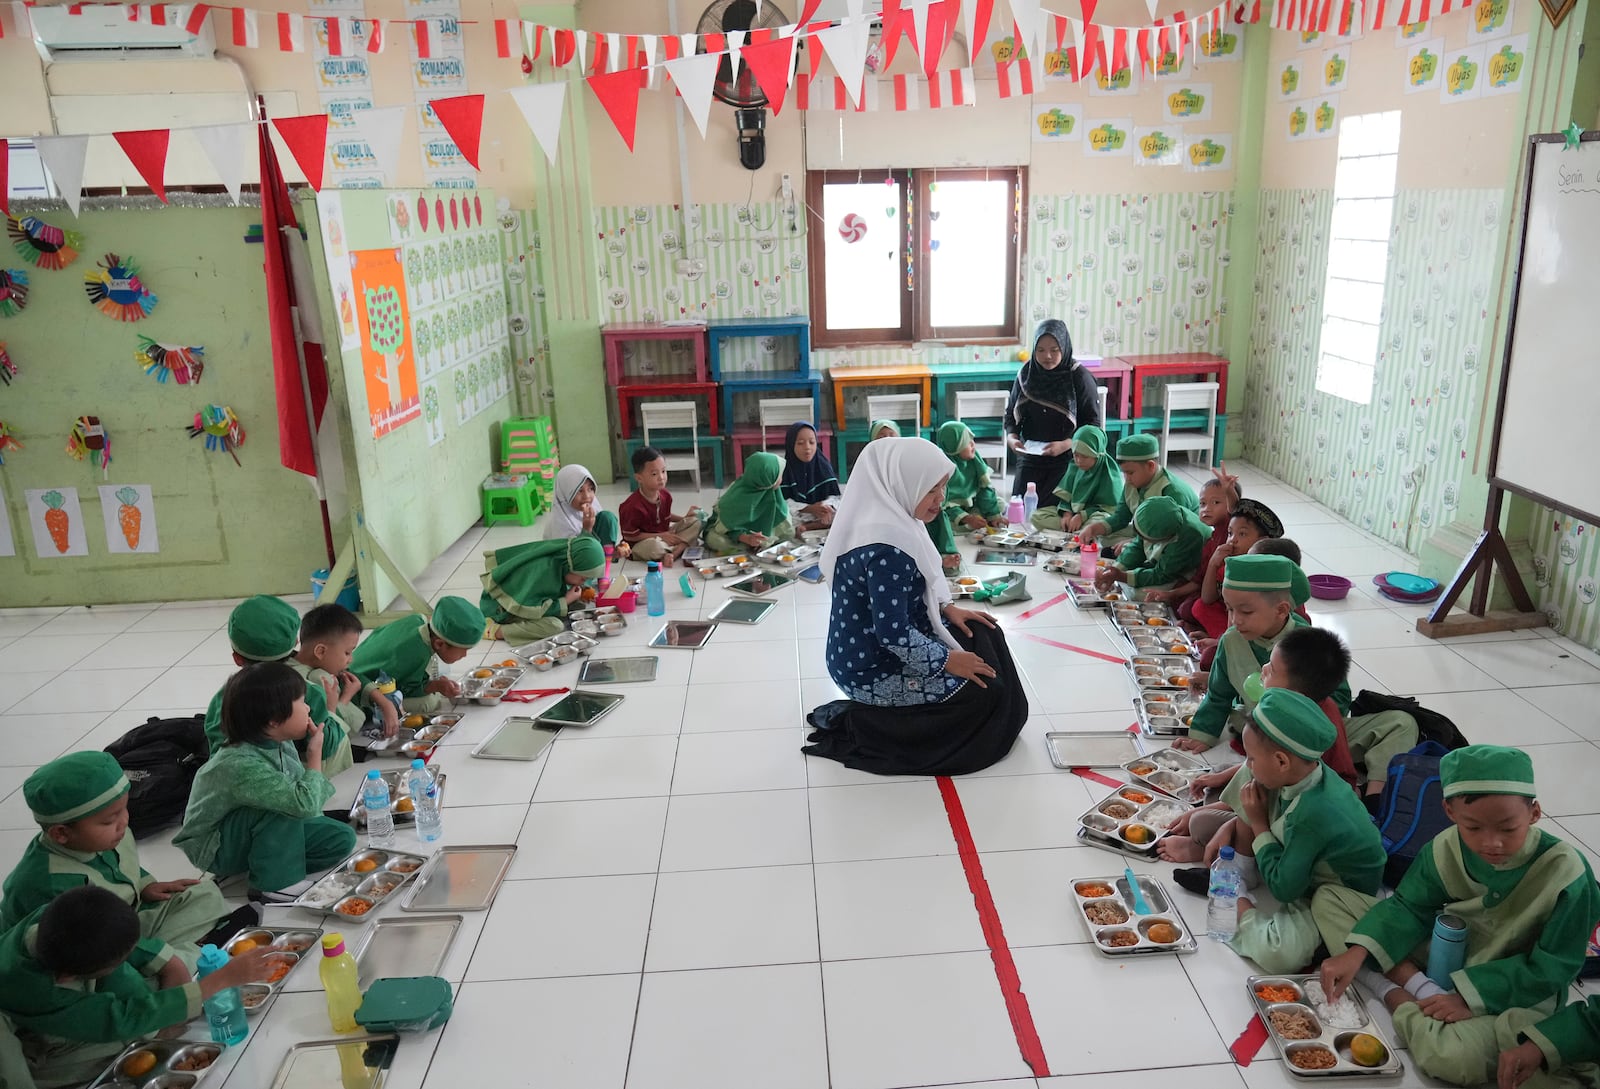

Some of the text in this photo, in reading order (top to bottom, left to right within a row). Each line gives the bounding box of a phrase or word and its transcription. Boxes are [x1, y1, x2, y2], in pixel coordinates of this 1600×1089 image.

[420, 61, 461, 76] ROMADHON
[1492, 61, 1518, 80] Ilyasa
[1451, 69, 1473, 86] Ilyas
[1171, 95, 1200, 109] Ismail
[1042, 115, 1070, 129] Ibrahim
[1092, 132, 1121, 144] Luth
[1193, 144, 1218, 158] Yusuf
[1558, 163, 1583, 187] Senin
